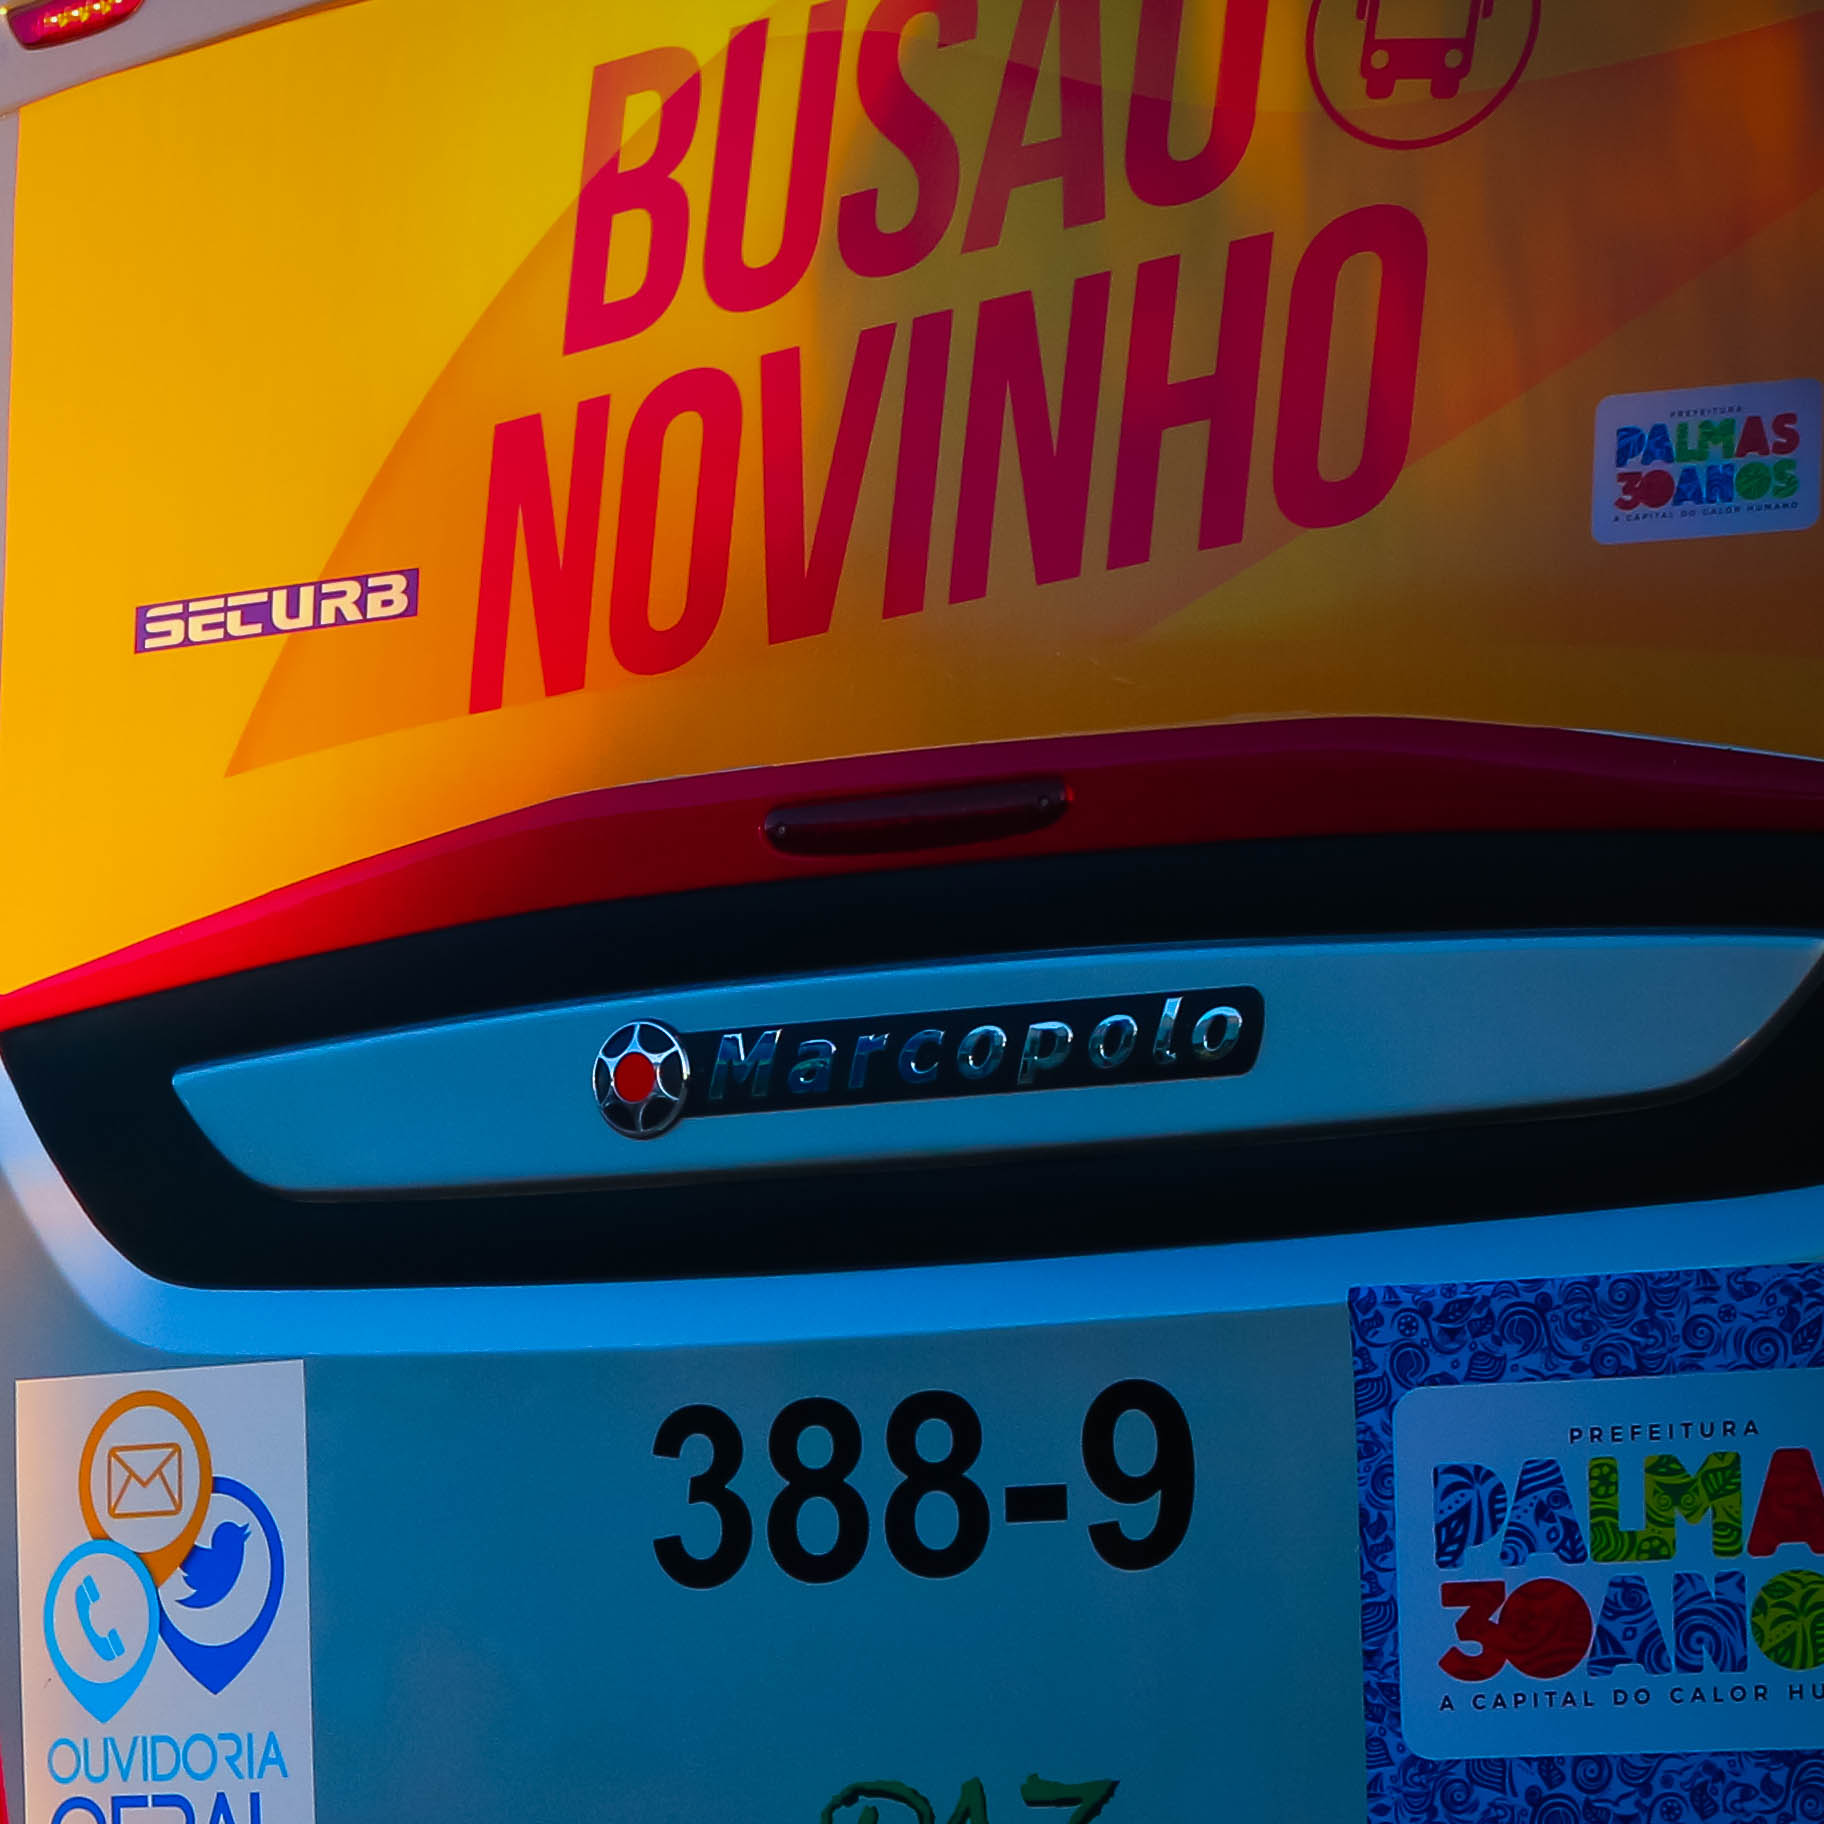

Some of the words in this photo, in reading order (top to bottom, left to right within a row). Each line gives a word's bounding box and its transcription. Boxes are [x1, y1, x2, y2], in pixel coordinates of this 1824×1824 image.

[468, 203, 1429, 715] NOVINHO
[1615, 412, 1801, 468] PALMAS
[144, 574, 409, 649] SECURB
[707, 996, 1244, 1101] Marcopolo
[1568, 1419, 1760, 1444] PREFEITURA
[651, 1376, 1195, 1591] 388-9
[1439, 1695, 1455, 1712] A
[1472, 1689, 1595, 1711] CAPITAL
[1614, 1688, 1651, 1707] DO
[1669, 1683, 1768, 1705] CALOR
[47, 1730, 289, 1785] OUVIDORIA
